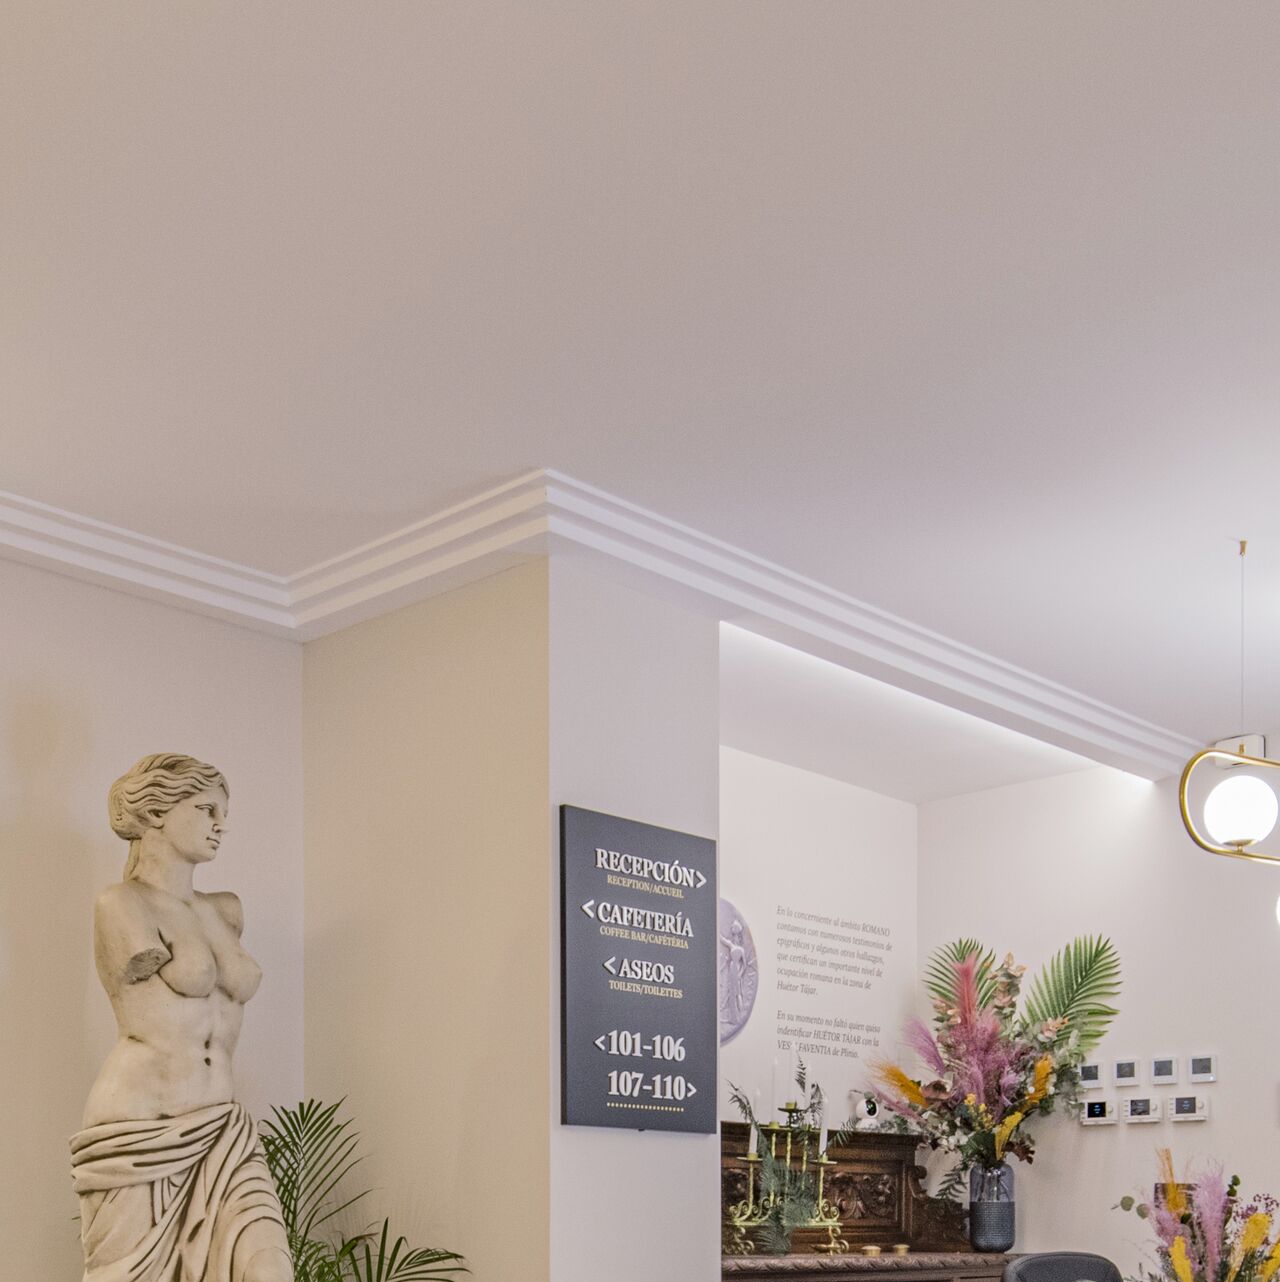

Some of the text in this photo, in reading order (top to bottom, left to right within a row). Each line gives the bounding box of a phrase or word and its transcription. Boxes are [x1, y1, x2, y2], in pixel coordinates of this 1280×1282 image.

[596, 848, 694, 887] RECEPCIÓN
[608, 875, 684, 898] RECEPTION/ACCUEIL
[597, 902, 694, 937] CAFETERÍA
[862, 923, 890, 937] ROMANO
[600, 926, 630, 939] COFFEE
[777, 922, 892, 952] contamos con numerosos testimonios de
[777, 937, 810, 950] epigráficos
[816, 944, 839, 956] algunos
[840, 949, 855, 959] otros
[619, 958, 674, 984] ASEOS
[777, 952, 883, 979] que certifican un importante nivel de
[609, 980, 683, 999] TOILETS/TOILETTES
[777, 967, 808, 979] ocupación
[810, 972, 832, 983] romana
[834, 977, 841, 985] en
[849, 979, 863, 989] zona
[864, 980, 872, 990] de
[777, 1010, 785, 1020] En
[787, 1013, 794, 1021] su
[795, 1015, 824, 1026] momento
[825, 1019, 832, 1027] no
[848, 1022, 865, 1032] quien
[608, 1030, 686, 1061] 101-106
[799, 1042, 831, 1056] FAVENTIA
[832, 1047, 840, 1056] de
[608, 1070, 686, 1101] 107-110
